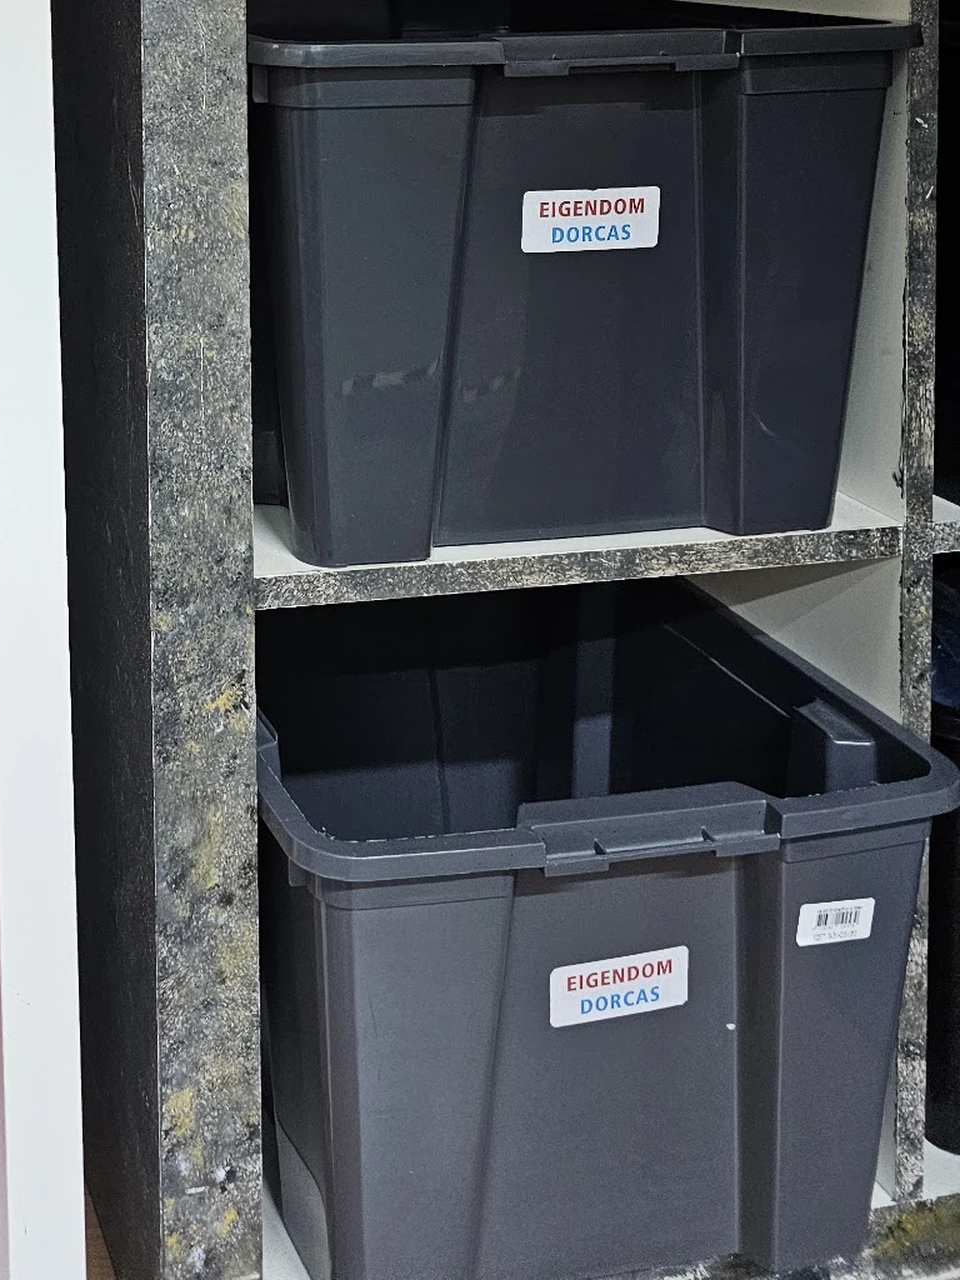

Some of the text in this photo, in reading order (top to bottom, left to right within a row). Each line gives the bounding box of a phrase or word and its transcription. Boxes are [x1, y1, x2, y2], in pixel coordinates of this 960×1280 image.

[539, 198, 645, 218] EIGENDOM
[552, 224, 632, 243] DORCAS
[566, 958, 674, 992] EIGENDOM
[580, 985, 661, 1015] DORCAS
